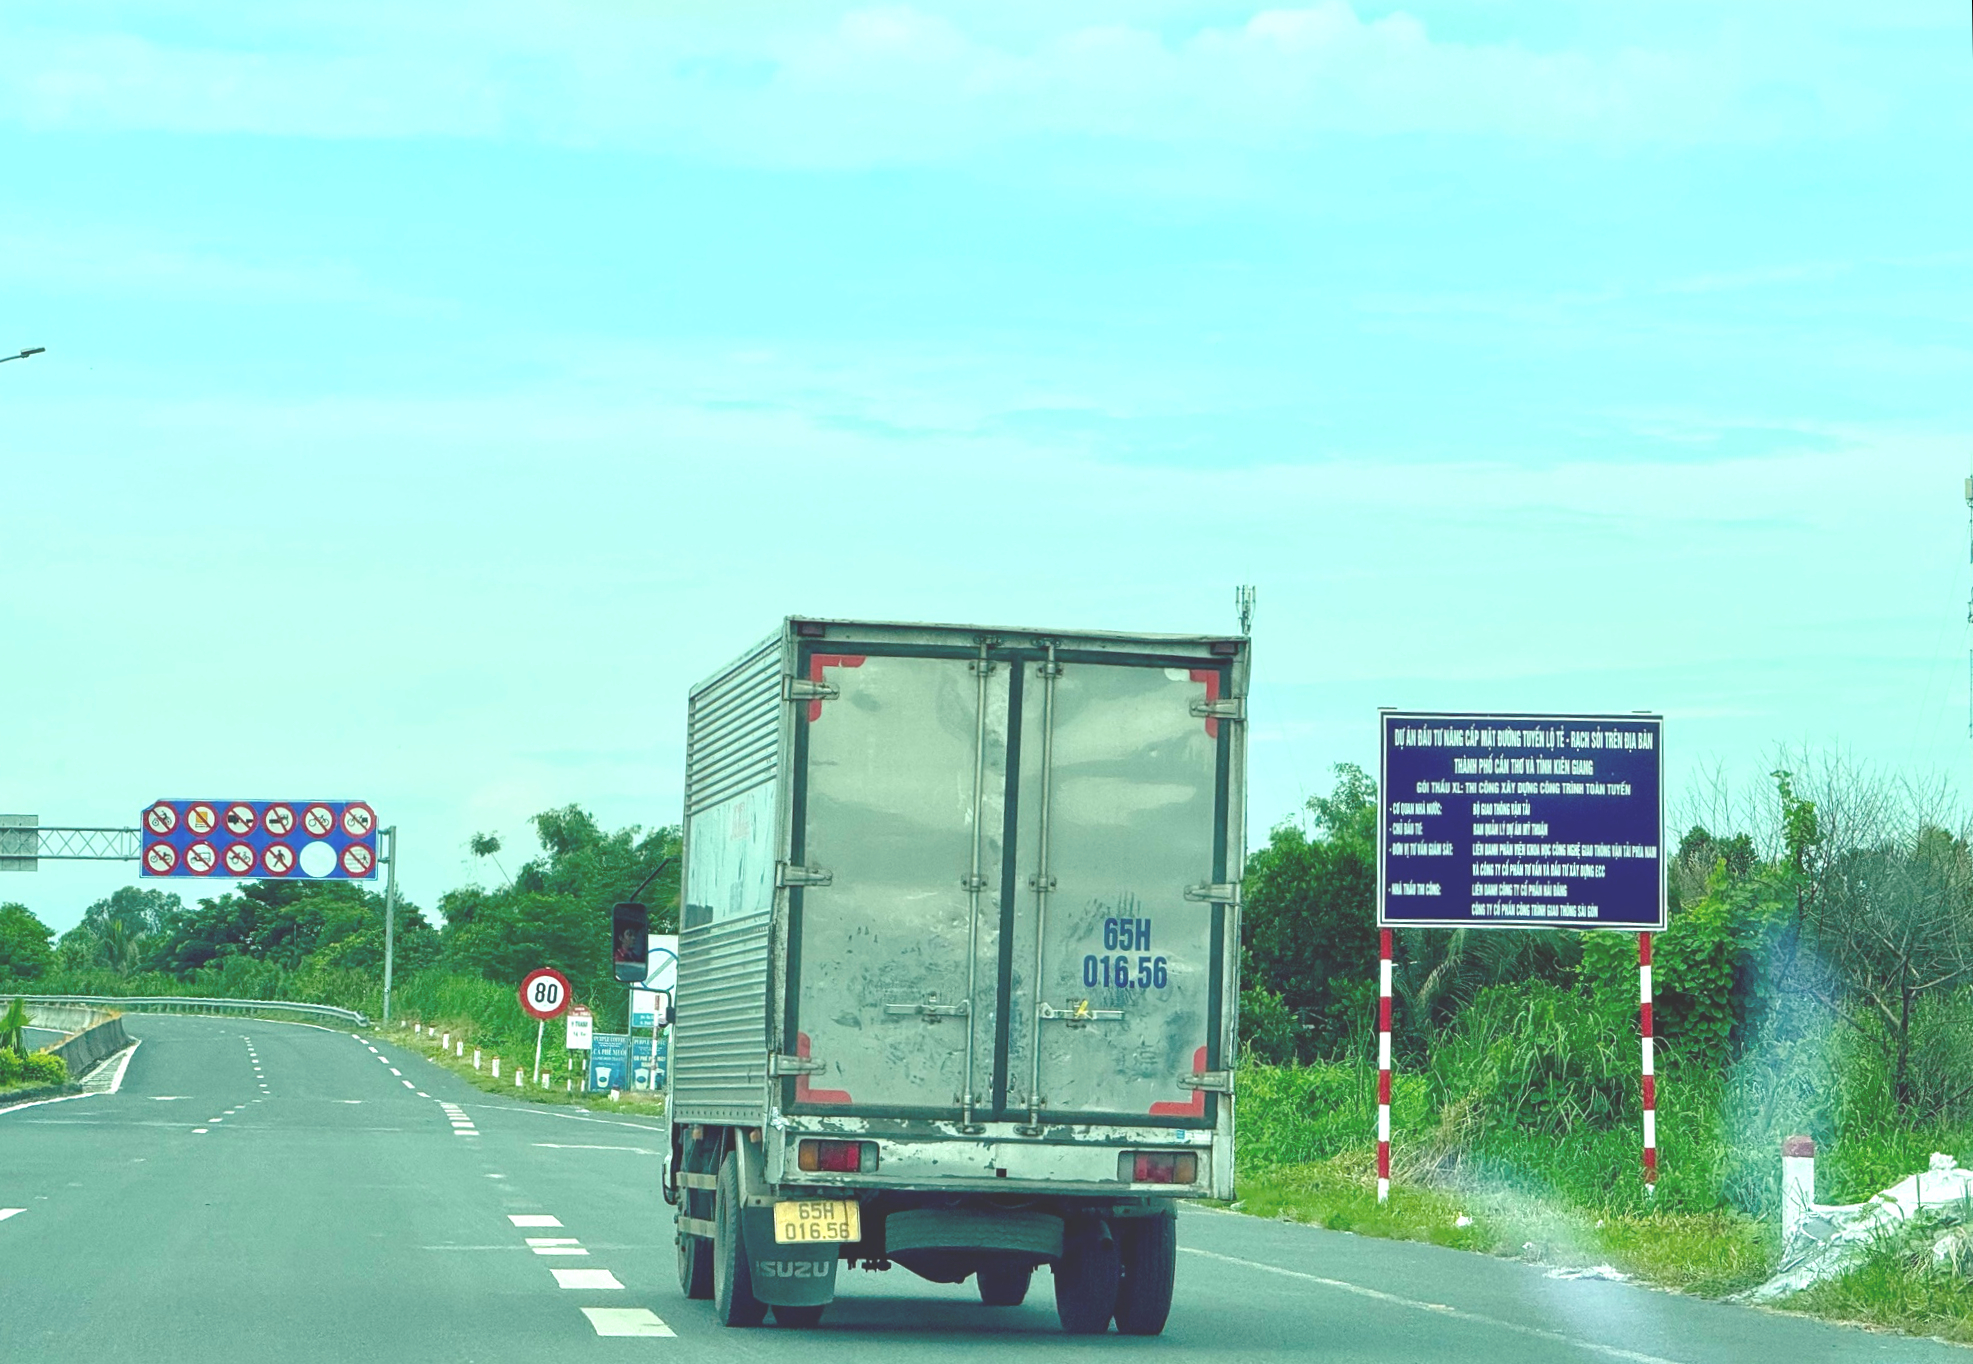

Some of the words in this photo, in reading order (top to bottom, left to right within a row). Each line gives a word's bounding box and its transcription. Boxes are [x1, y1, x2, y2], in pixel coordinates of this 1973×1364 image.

[1444, 726, 1464, 746] NÂNG
[1465, 723, 1480, 746] CẤP
[1522, 725, 1544, 748] TUYẾN
[1546, 727, 1555, 752] LỘ
[1570, 730, 1590, 752] RẠCH
[1604, 728, 1622, 749] TRÊN
[1454, 754, 1478, 774] THÀNH
[1478, 753, 1493, 774] PHỐ
[1511, 758, 1524, 774] THƠ
[1526, 756, 1535, 774] VÀ
[1554, 756, 1570, 774] KIÊN
[1572, 760, 1594, 776] GIANG
[1416, 780, 1430, 794] GÓI
[1465, 782, 1477, 794] THI
[1478, 780, 1500, 794] CÔNG
[1501, 780, 1516, 794] XÂY
[1518, 781, 1538, 796] DỰNG
[1540, 780, 1560, 794] CÔNG
[1562, 780, 1584, 794] TRÌNH
[1585, 781, 1605, 794] TOÀN
[1607, 780, 1631, 796] TUYẾN
[1481, 803, 1492, 816] GIAO
[1494, 800, 1510, 816] THÔNG
[1645, 846, 1657, 858] NAM
[1480, 861, 1494, 876] CÔNG
[1495, 864, 1501, 876] TY
[1104, 918, 1151, 952] 65H
[1083, 954, 1168, 989] 016.56
[534, 982, 558, 1004] 80
[798, 1202, 834, 1220] 65H
[785, 1222, 850, 1240] 016.56
[756, 1260, 830, 1278] ISUZU
